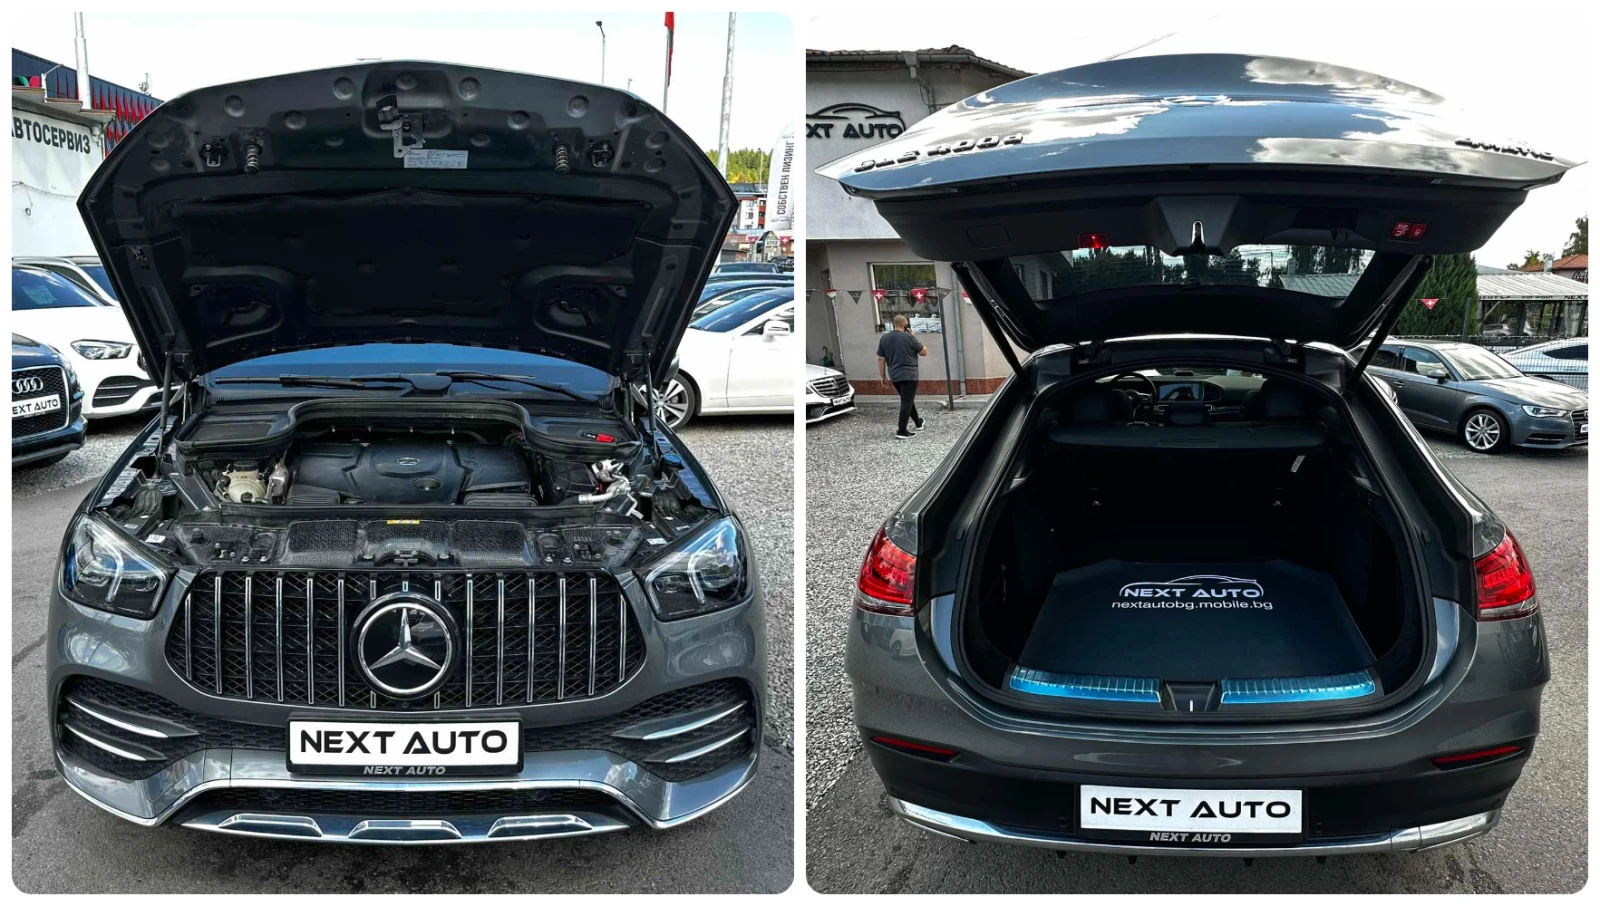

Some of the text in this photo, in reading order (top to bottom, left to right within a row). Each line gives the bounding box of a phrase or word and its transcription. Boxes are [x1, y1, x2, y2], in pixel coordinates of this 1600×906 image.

[11, 117, 91, 154] ВТОСЕРВИЗ
[843, 123, 902, 138] AUTO
[782, 141, 795, 173] ЛИЗИНГ
[777, 174, 790, 215] СОБСТВЕН
[34, 399, 59, 411] AUTO
[1124, 588, 1261, 598] NEXT AUTO
[1111, 600, 1274, 611] nextautobg.mobile.bg
[300, 729, 508, 755] NEXT AUTO
[363, 766, 446, 775] NEXT AUTO
[1090, 796, 1291, 819] NEXT AUTO
[1149, 832, 1232, 843] NEXT AUTO
